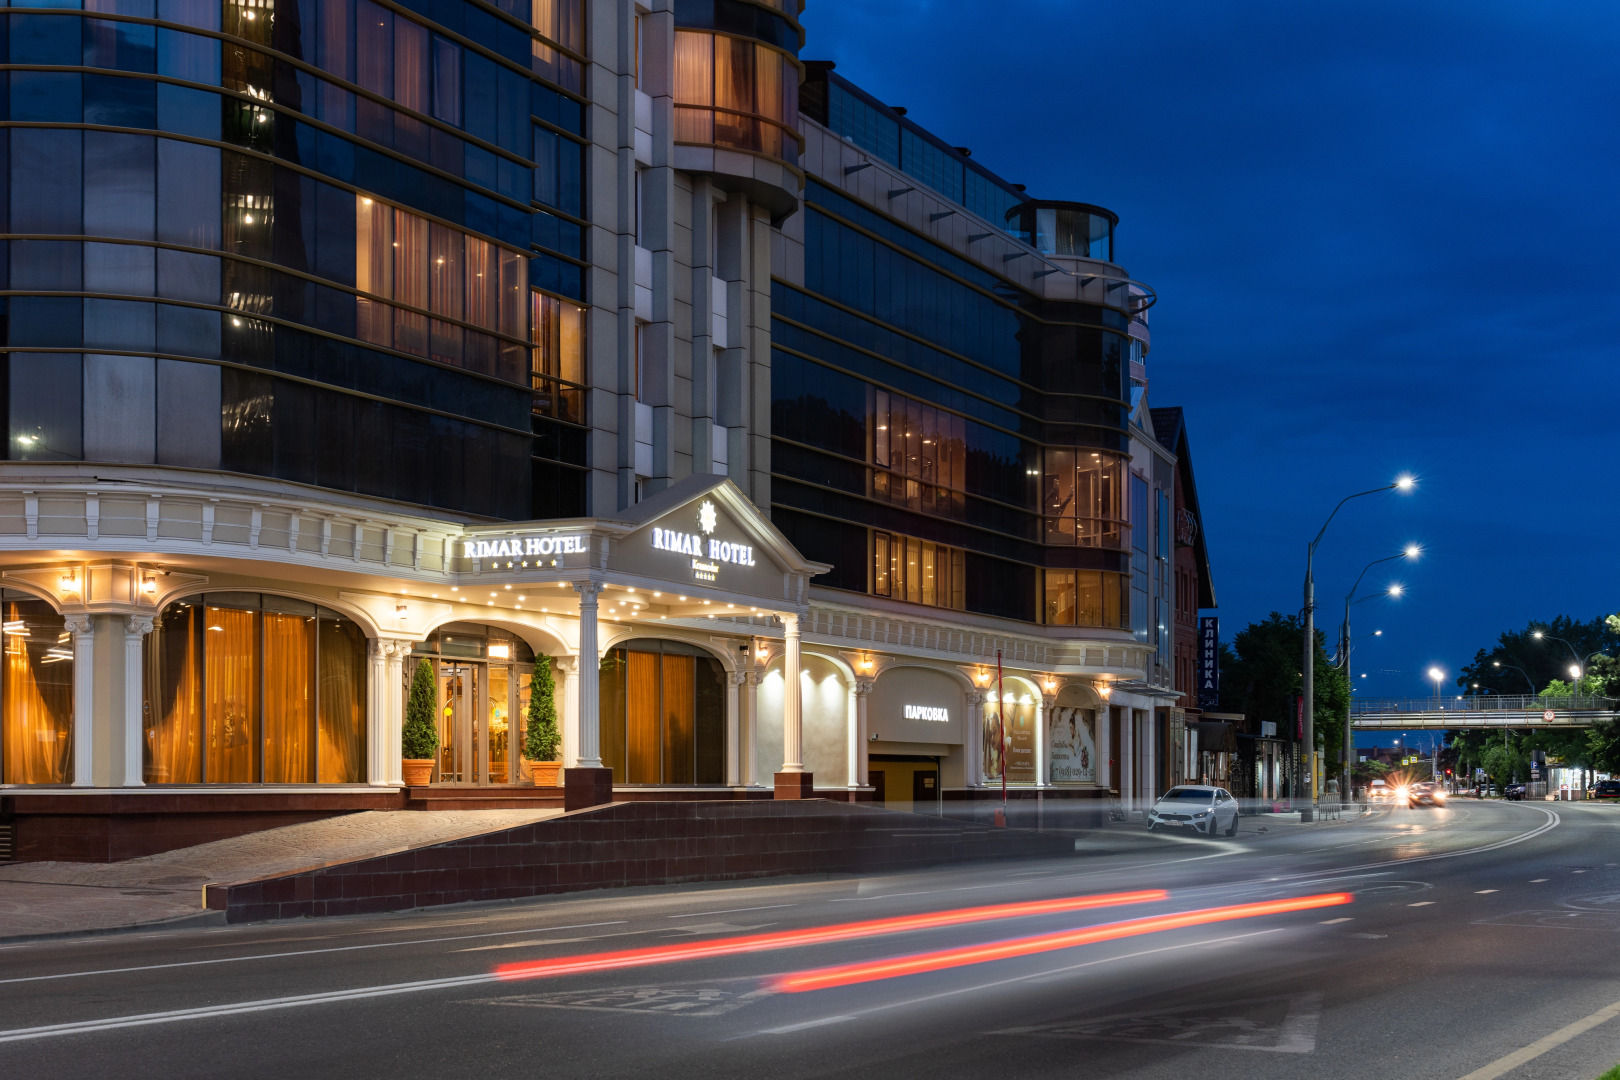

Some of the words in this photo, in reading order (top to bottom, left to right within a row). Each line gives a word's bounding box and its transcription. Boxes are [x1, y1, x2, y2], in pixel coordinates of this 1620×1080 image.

[464, 538, 524, 559] RIMAR
[525, 536, 586, 555] HOTEL
[652, 527, 702, 557] RIMAR
[708, 538, 756, 567] HOTEL
[1203, 619, 1214, 690] КЛИНИКА
[905, 705, 949, 722] ПАРКОВКА
